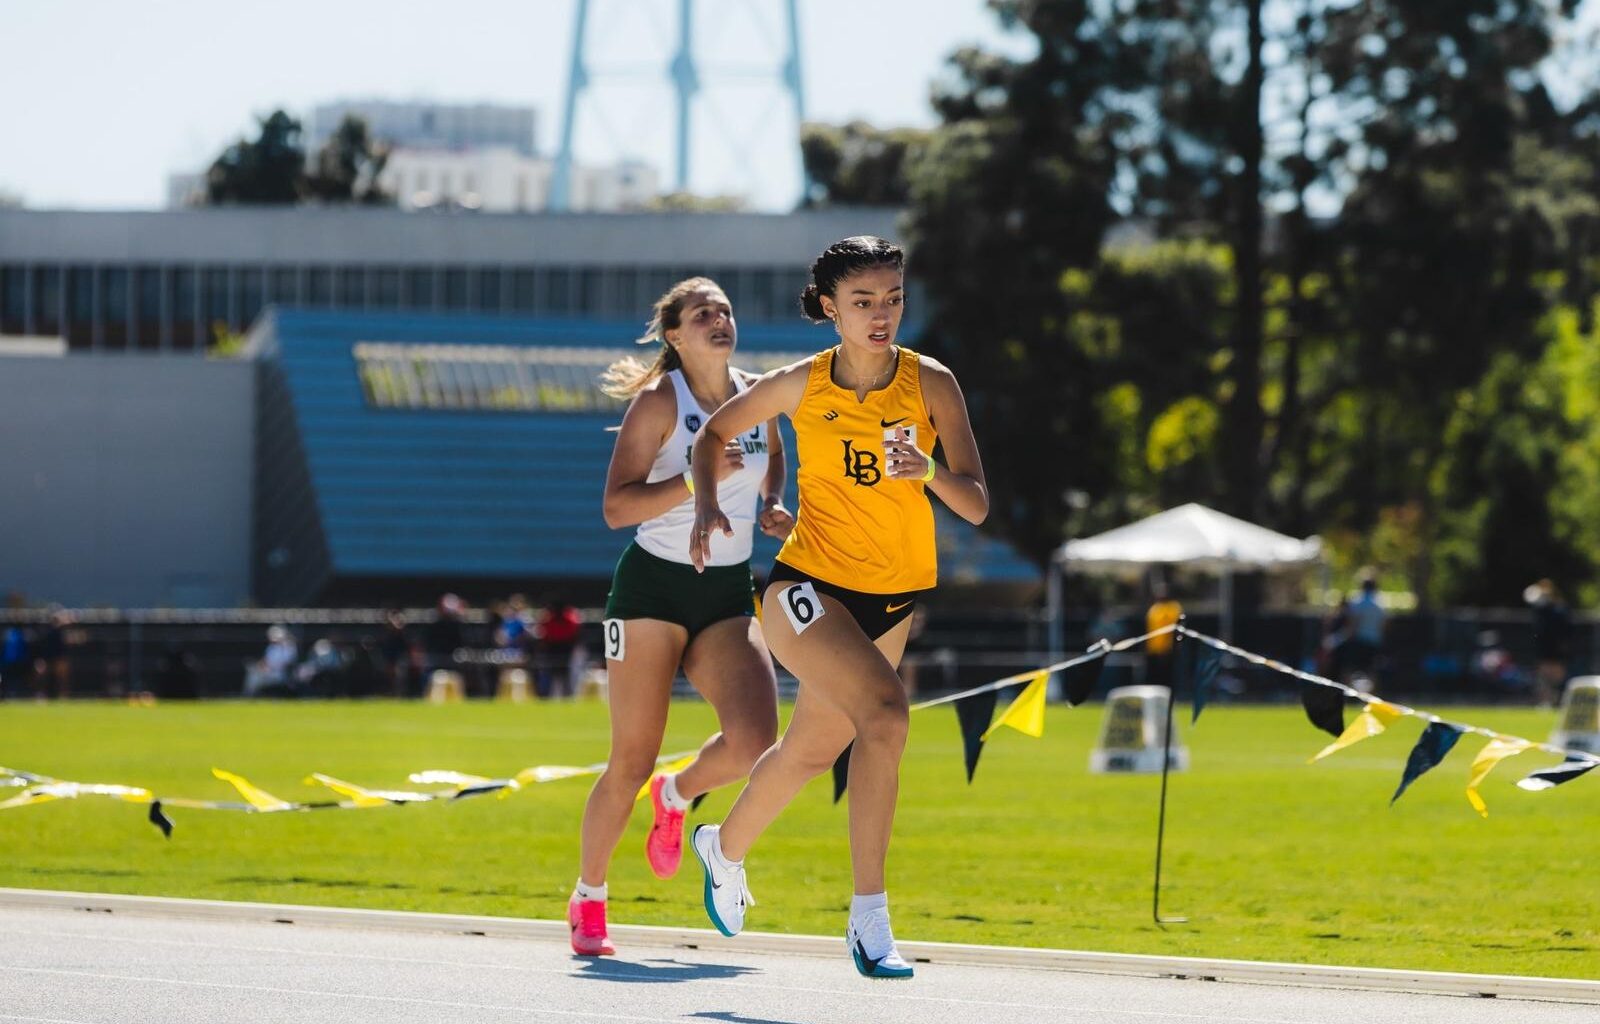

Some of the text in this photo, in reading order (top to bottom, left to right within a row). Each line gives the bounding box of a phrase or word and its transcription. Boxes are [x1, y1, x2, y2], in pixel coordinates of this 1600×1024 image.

[841, 439, 881, 486] LB
[787, 584, 814, 624] 6
[608, 620, 620, 657] 9
